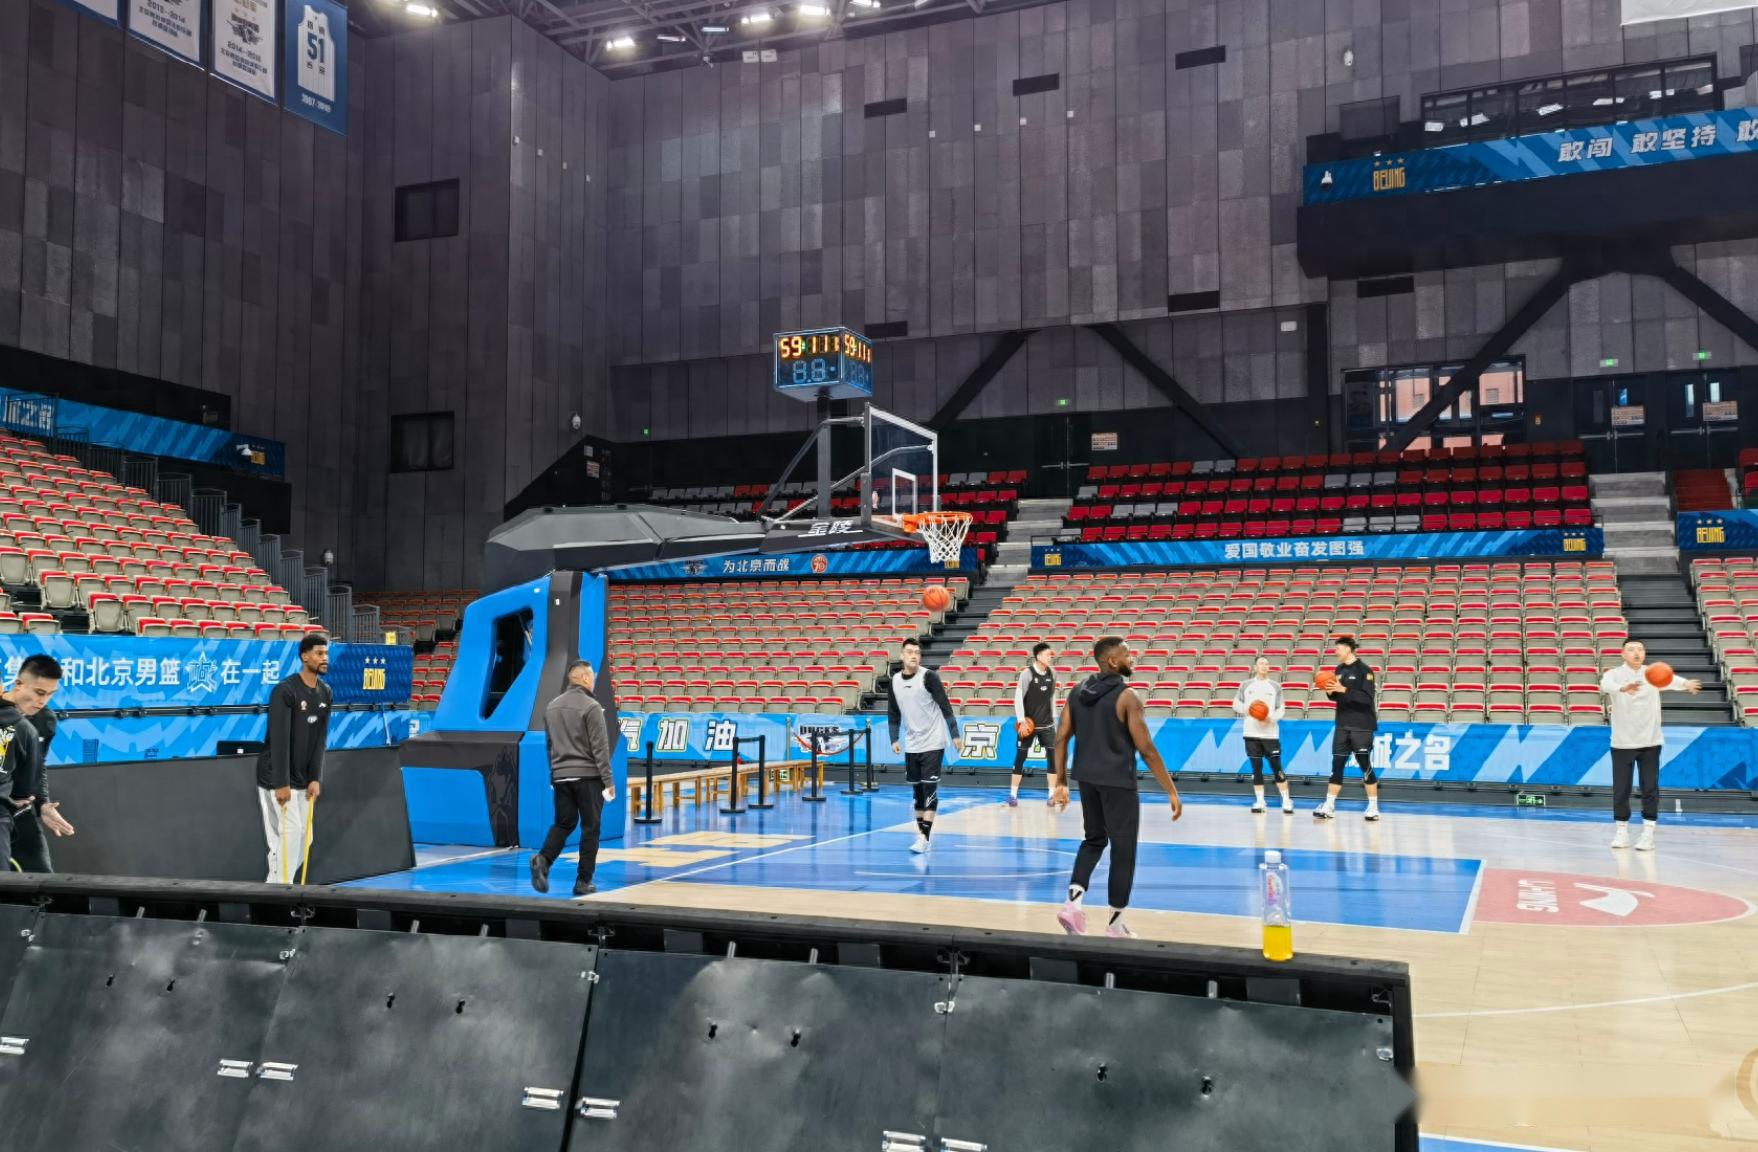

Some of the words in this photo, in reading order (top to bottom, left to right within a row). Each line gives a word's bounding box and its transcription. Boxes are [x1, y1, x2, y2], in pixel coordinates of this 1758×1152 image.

[307, 32, 325, 63] 51
[1558, 137, 1613, 163] 敢闯
[1631, 124, 1716, 154] 敢坚持
[1373, 167, 1405, 191] BEIJING
[1224, 540, 1365, 559] 爱国敬业奋发图强
[723, 558, 790, 573] 为北京而战
[3, 656, 181, 687] 集和北京男篮
[221, 659, 280, 685] 在一起
[961, 723, 999, 759] 京
